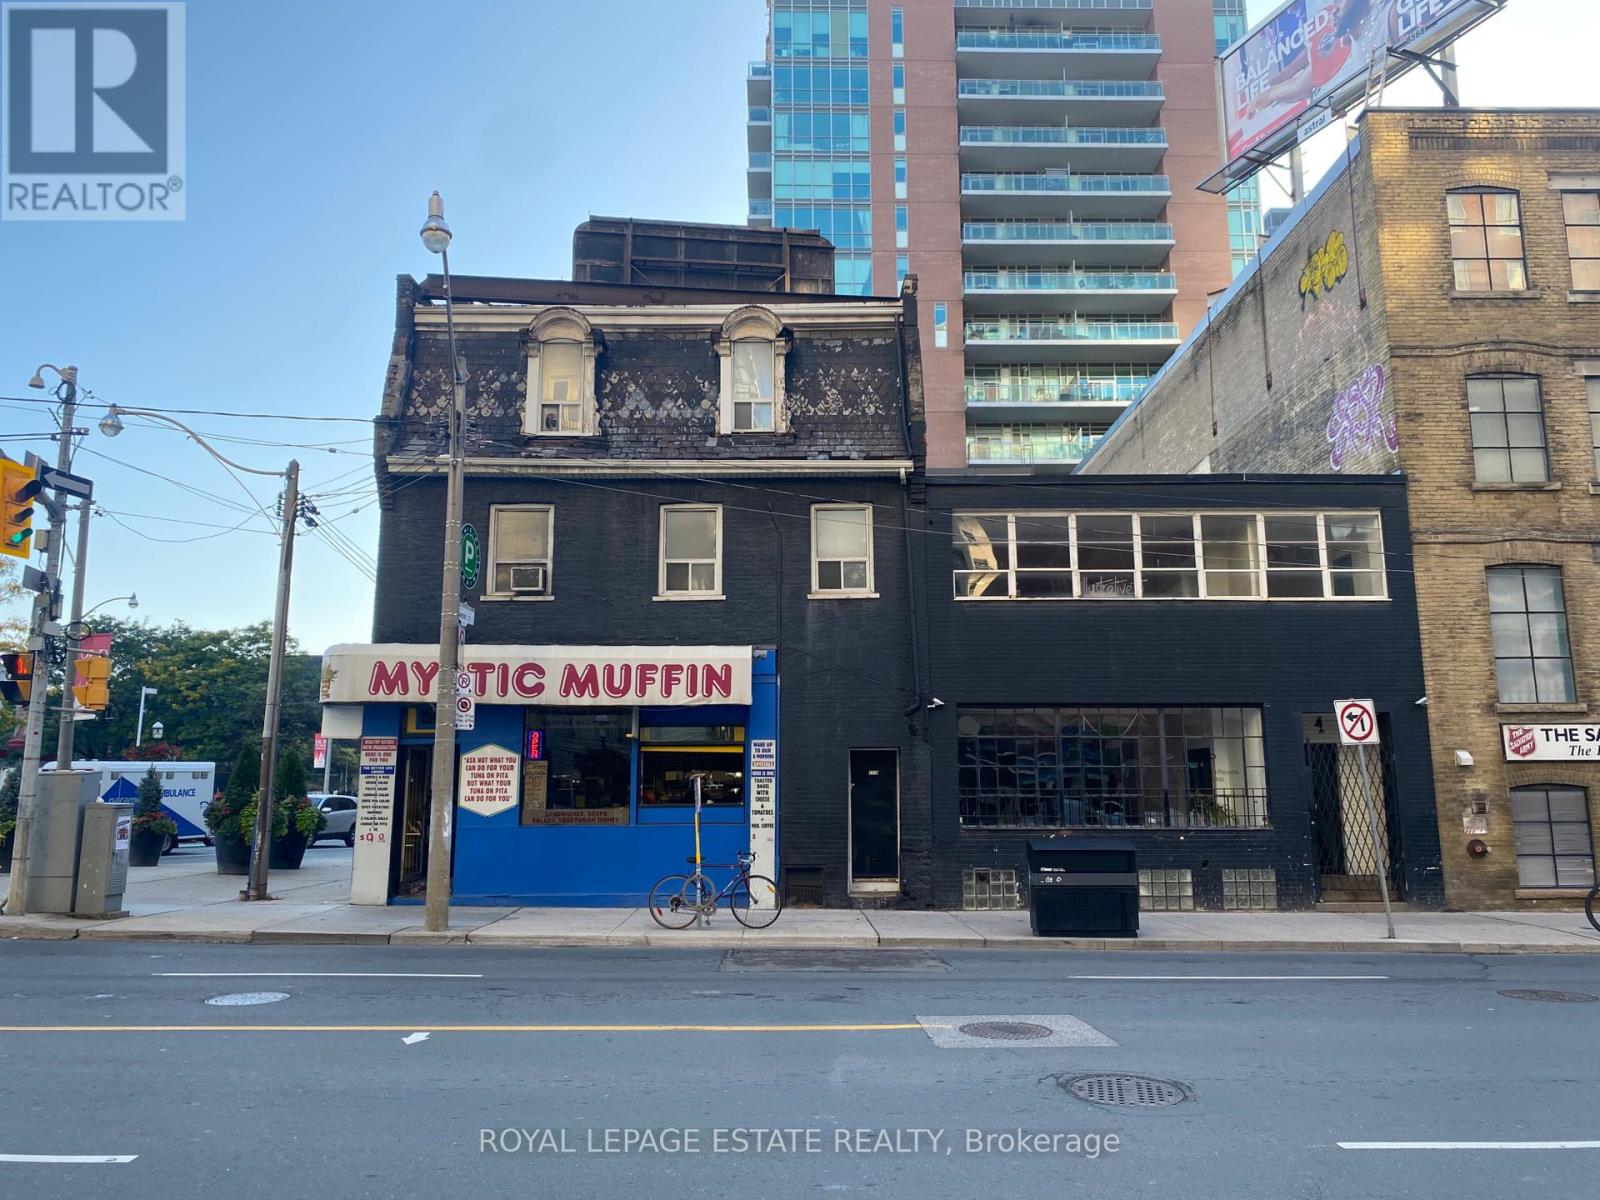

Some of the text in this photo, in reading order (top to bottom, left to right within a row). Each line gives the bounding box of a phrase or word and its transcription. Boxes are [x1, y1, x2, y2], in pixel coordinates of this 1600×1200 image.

[1236, 10, 1329, 92] BALANCED
[1303, 114, 1326, 135] astral
[368, 660, 732, 699] MYTIC MUFFIN
[1540, 728, 1580, 742] THE
[1519, 741, 1534, 755] ARMY
[1569, 745, 1592, 757] The
[160, 789, 196, 797] MBULANCE
